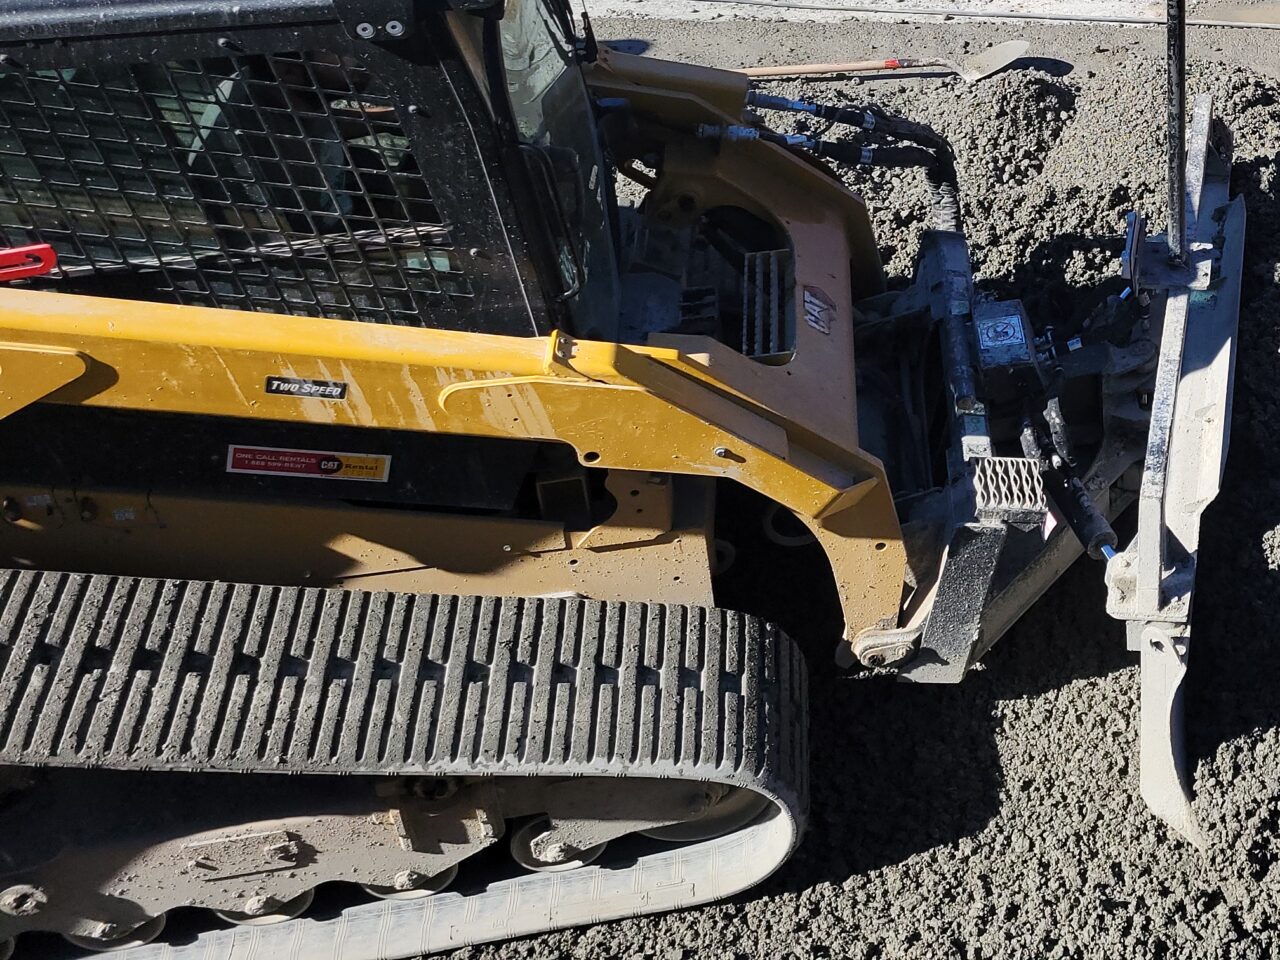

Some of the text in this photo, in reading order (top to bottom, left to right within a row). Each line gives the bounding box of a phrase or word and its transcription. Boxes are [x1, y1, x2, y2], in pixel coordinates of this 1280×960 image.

[279, 455, 317, 464] RENTALS
[320, 460, 340, 469] CAT
[344, 463, 378, 471] Rental
